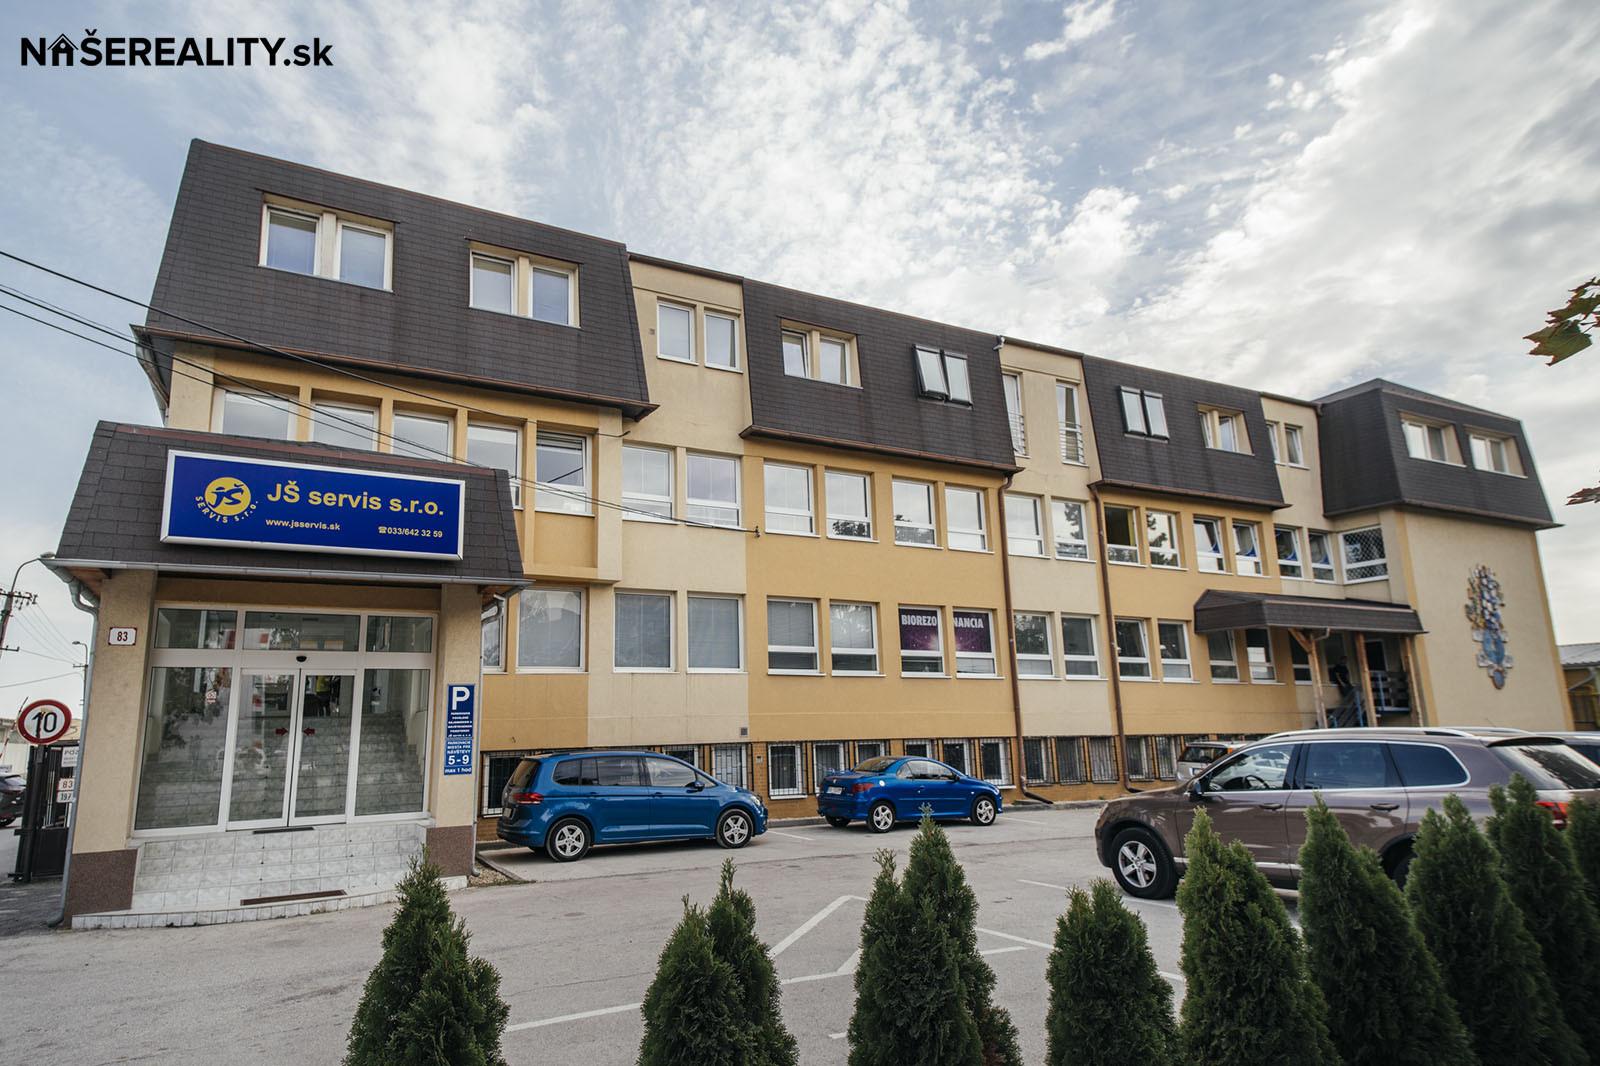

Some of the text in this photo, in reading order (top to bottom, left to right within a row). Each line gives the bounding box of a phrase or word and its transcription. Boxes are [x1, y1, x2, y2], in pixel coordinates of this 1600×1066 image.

[267, 480, 444, 516] JŠ servis s.r.o.
[195, 495, 228, 524] SERVIS
[265, 519, 341, 531] www.jsservis.sk
[421, 529, 431, 537] 32
[433, 530, 443, 538] 59
[901, 614, 938, 626] BIOREZO
[117, 630, 128, 642] 83
[452, 686, 470, 710] P
[31, 711, 58, 739] 10
[448, 755, 455, 765] 5
[462, 754, 470, 765] 9
[62, 780, 73, 788] 83
